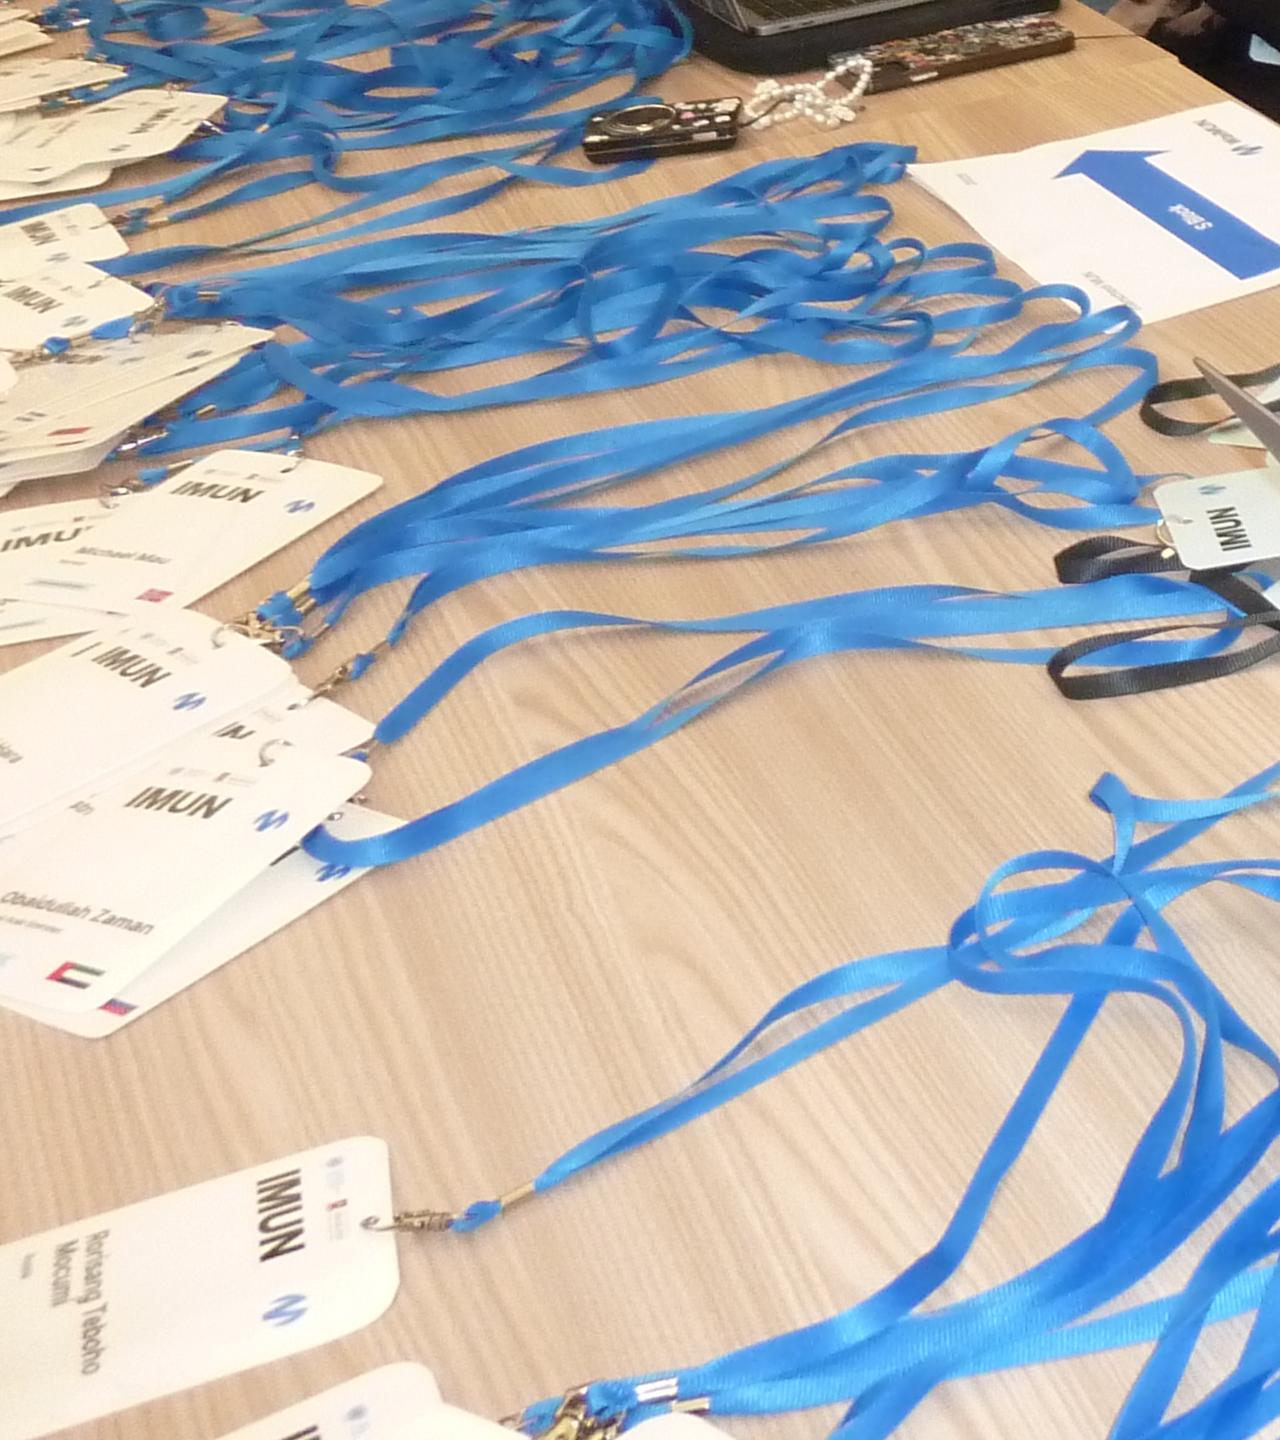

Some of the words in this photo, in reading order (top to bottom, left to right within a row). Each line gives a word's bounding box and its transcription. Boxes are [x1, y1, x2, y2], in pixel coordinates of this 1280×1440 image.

[170, 480, 266, 503] IMUN
[1, 525, 95, 552] IMU
[1206, 505, 1252, 552] IMUN
[91, 646, 172, 688] IMUN
[123, 786, 233, 819] IMUN
[89, 908, 155, 935] Zaman
[256, 1168, 306, 1263] IMUN
